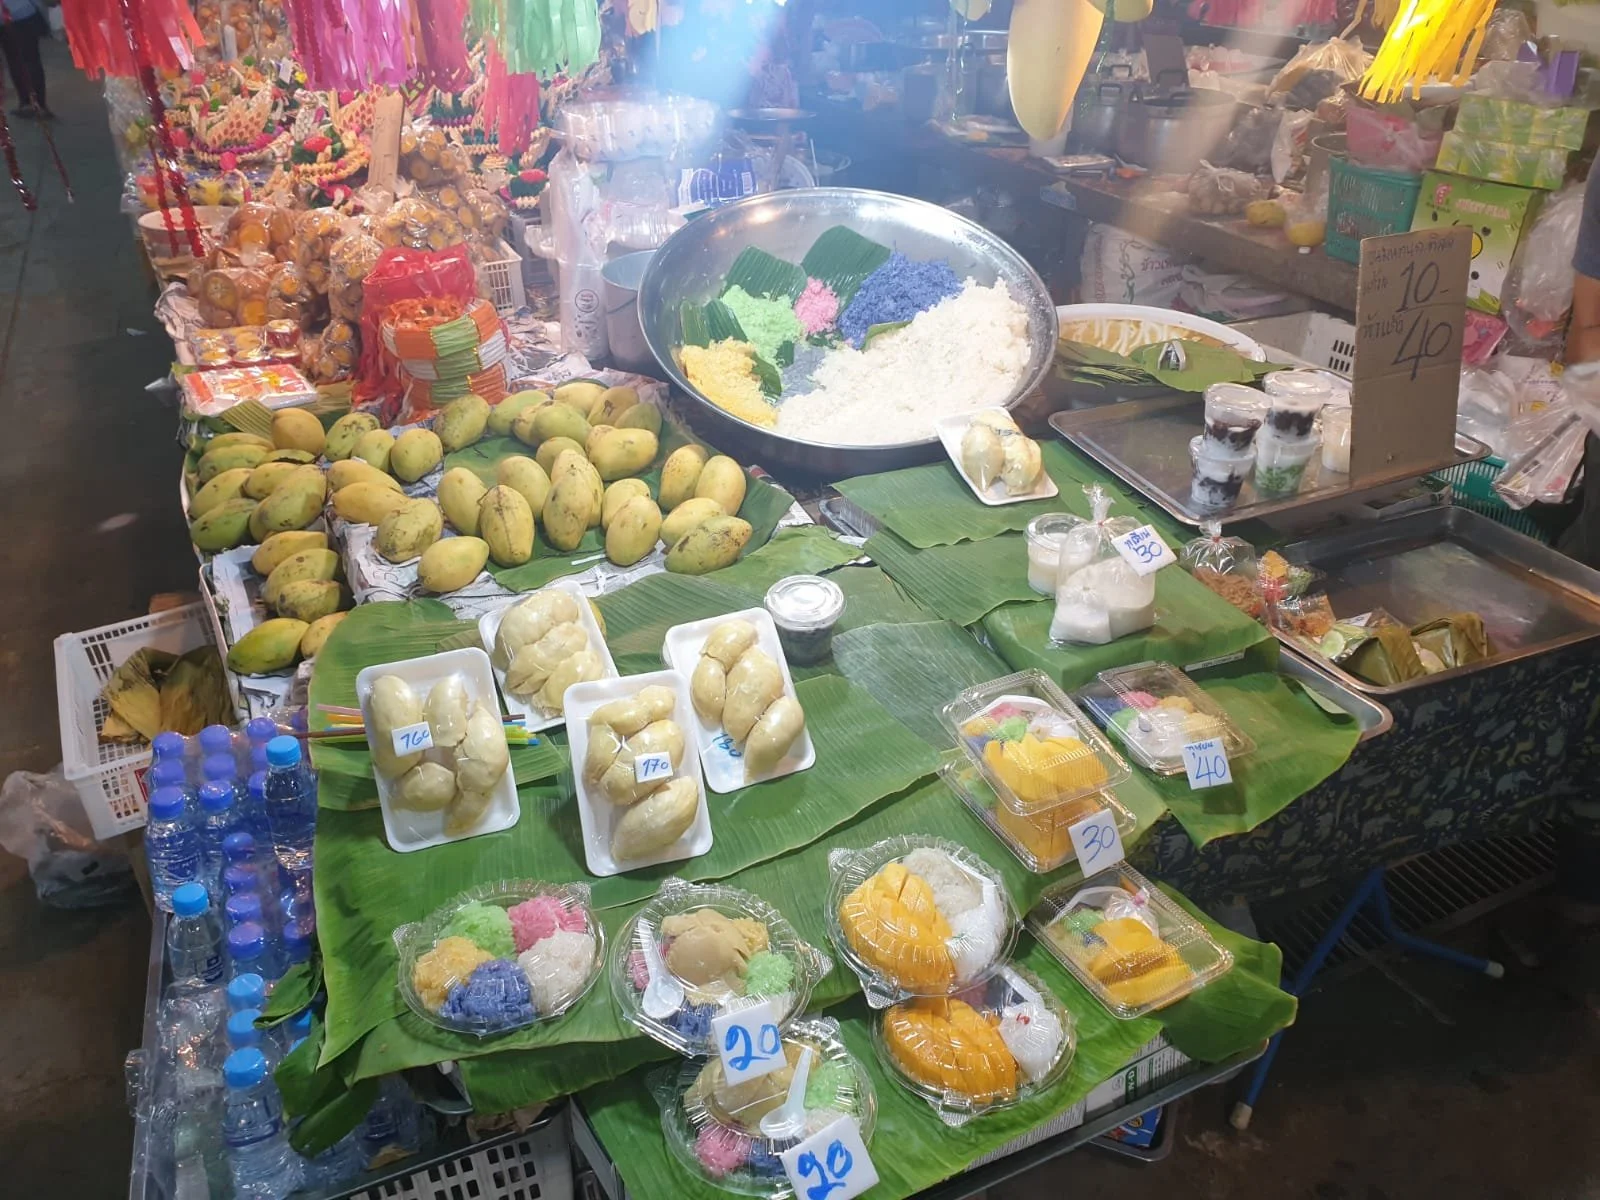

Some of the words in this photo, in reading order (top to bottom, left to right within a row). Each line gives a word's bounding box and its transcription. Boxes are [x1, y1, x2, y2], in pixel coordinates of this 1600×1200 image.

[1391, 310, 1452, 381] 40
[1132, 540, 1163, 564] 30
[642, 758, 669, 777] 170
[1195, 754, 1227, 787] 40
[1081, 824, 1116, 864] 30
[724, 1023, 781, 1071] 20
[797, 1138, 853, 1200] 20
